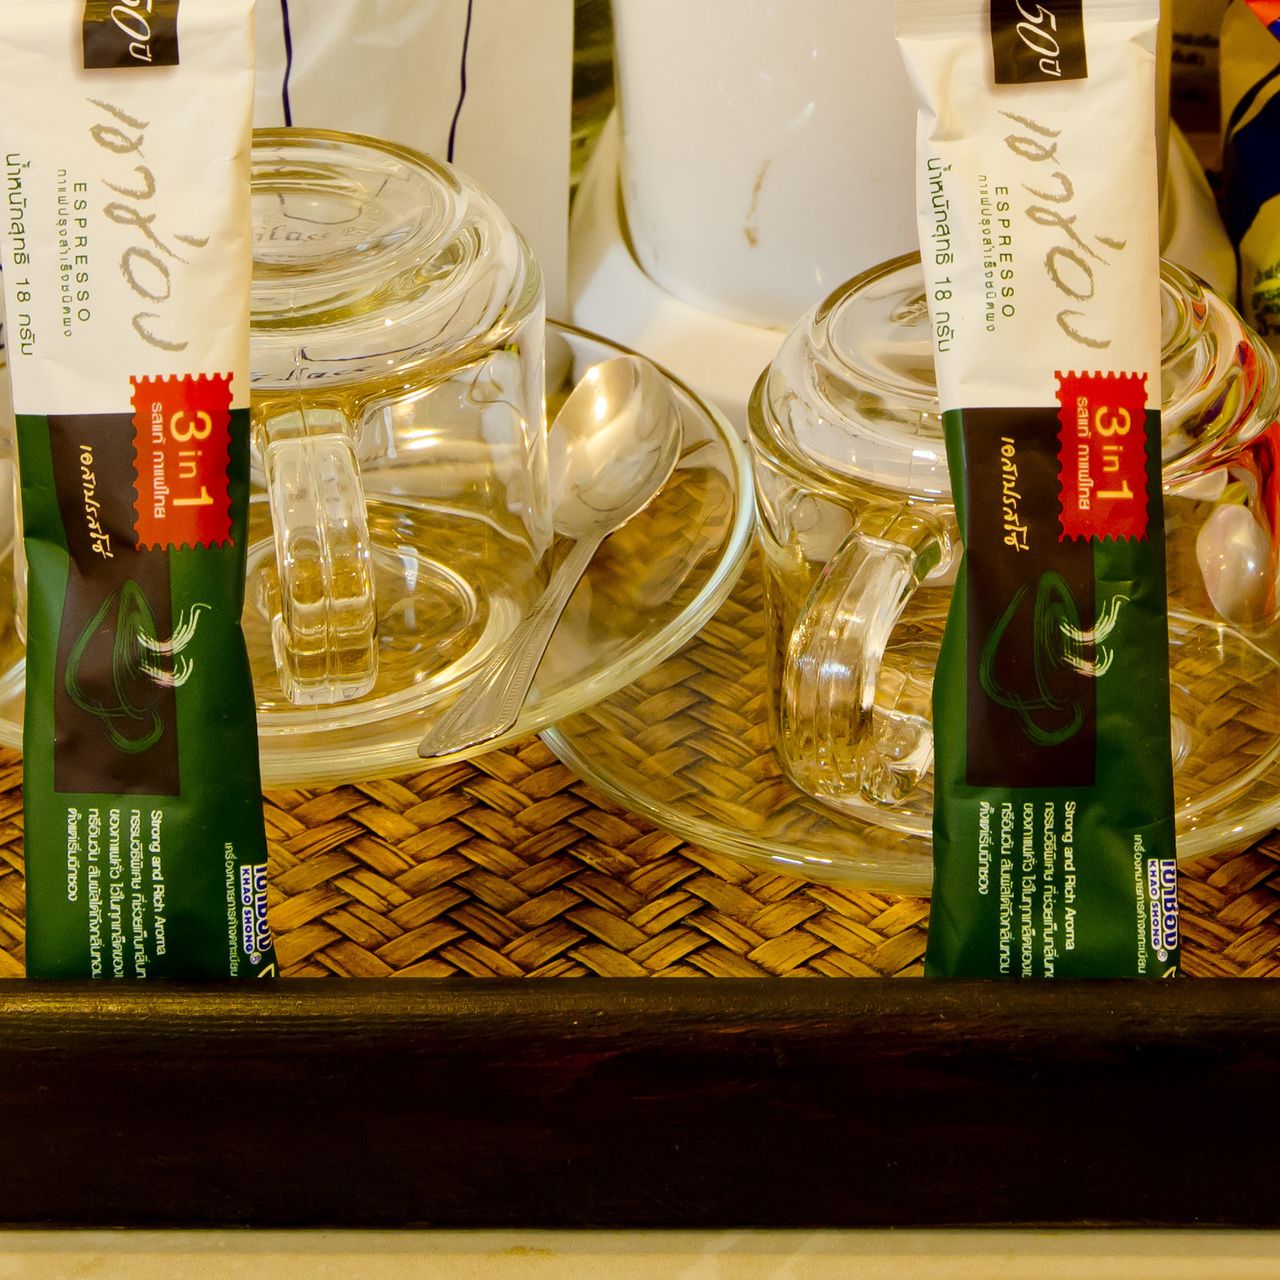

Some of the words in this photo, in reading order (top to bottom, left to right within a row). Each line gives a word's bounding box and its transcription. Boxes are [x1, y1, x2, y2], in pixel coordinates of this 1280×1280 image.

[5, 152, 31, 266] น้ำหนักสุทธิ
[85, 97, 210, 353] เขาช่อง
[926, 157, 954, 265] น้ำหนักสุทธิ
[997, 109, 1128, 350] เขาช่อง
[73, 182, 91, 323] ESPRESSO
[995, 186, 1015, 318] ESPRESSO
[15, 279, 31, 303] 18
[935, 279, 953, 301] 18
[17, 312, 37, 357] กรัม
[936, 310, 955, 353] กรัม
[151, 401, 166, 445] รสแท้
[170, 412, 213, 443] 3
[1077, 397, 1092, 440] รสแท้
[1095, 407, 1131, 437] 3
[178, 450, 202, 479] in
[1078, 444, 1094, 511] กาแฟไทย
[1102, 445, 1123, 472] in
[152, 449, 170, 519] กาแฟไทย
[172, 486, 214, 507] 1
[1096, 483, 1134, 501] 1
[150, 809, 163, 853] Strong
[1063, 801, 1077, 843] Strong
[151, 855, 162, 881] and
[1064, 846, 1075, 873] and
[1148, 859, 1158, 898] KHAO
[152, 882, 163, 913] Rich
[242, 868, 252, 905] KHAO
[1064, 876, 1076, 907] Rich
[151, 915, 166, 956] Aroma
[244, 909, 254, 952] SHONG
[1064, 908, 1077, 951] Aroma
[1151, 902, 1161, 949] SHONG
